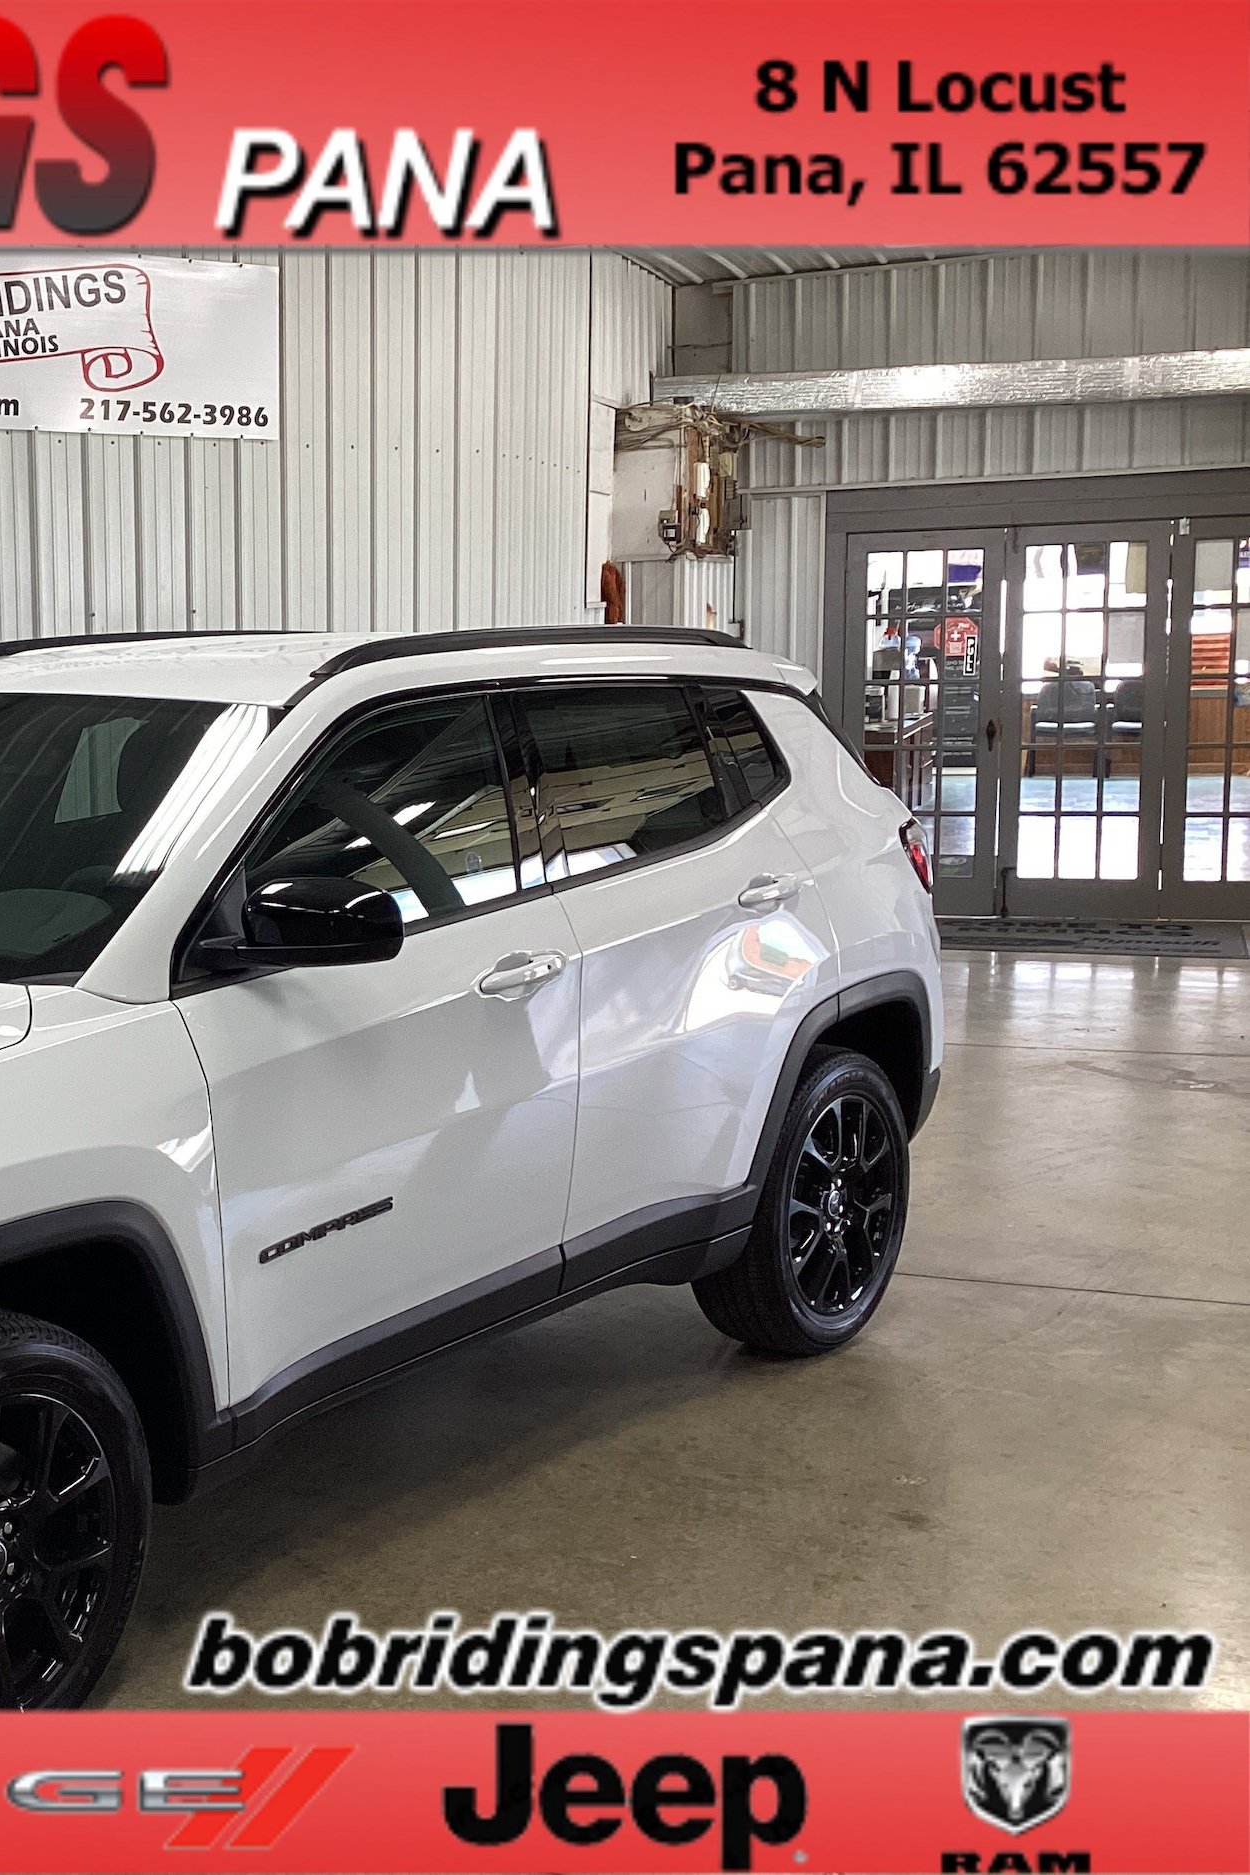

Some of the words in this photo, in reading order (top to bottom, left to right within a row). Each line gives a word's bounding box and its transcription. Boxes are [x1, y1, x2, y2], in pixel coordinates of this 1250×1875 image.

[79, 397, 269, 428] 217-562-3986
[966, 638, 975, 672] PULL
[259, 1196, 394, 1264] COMPASS
